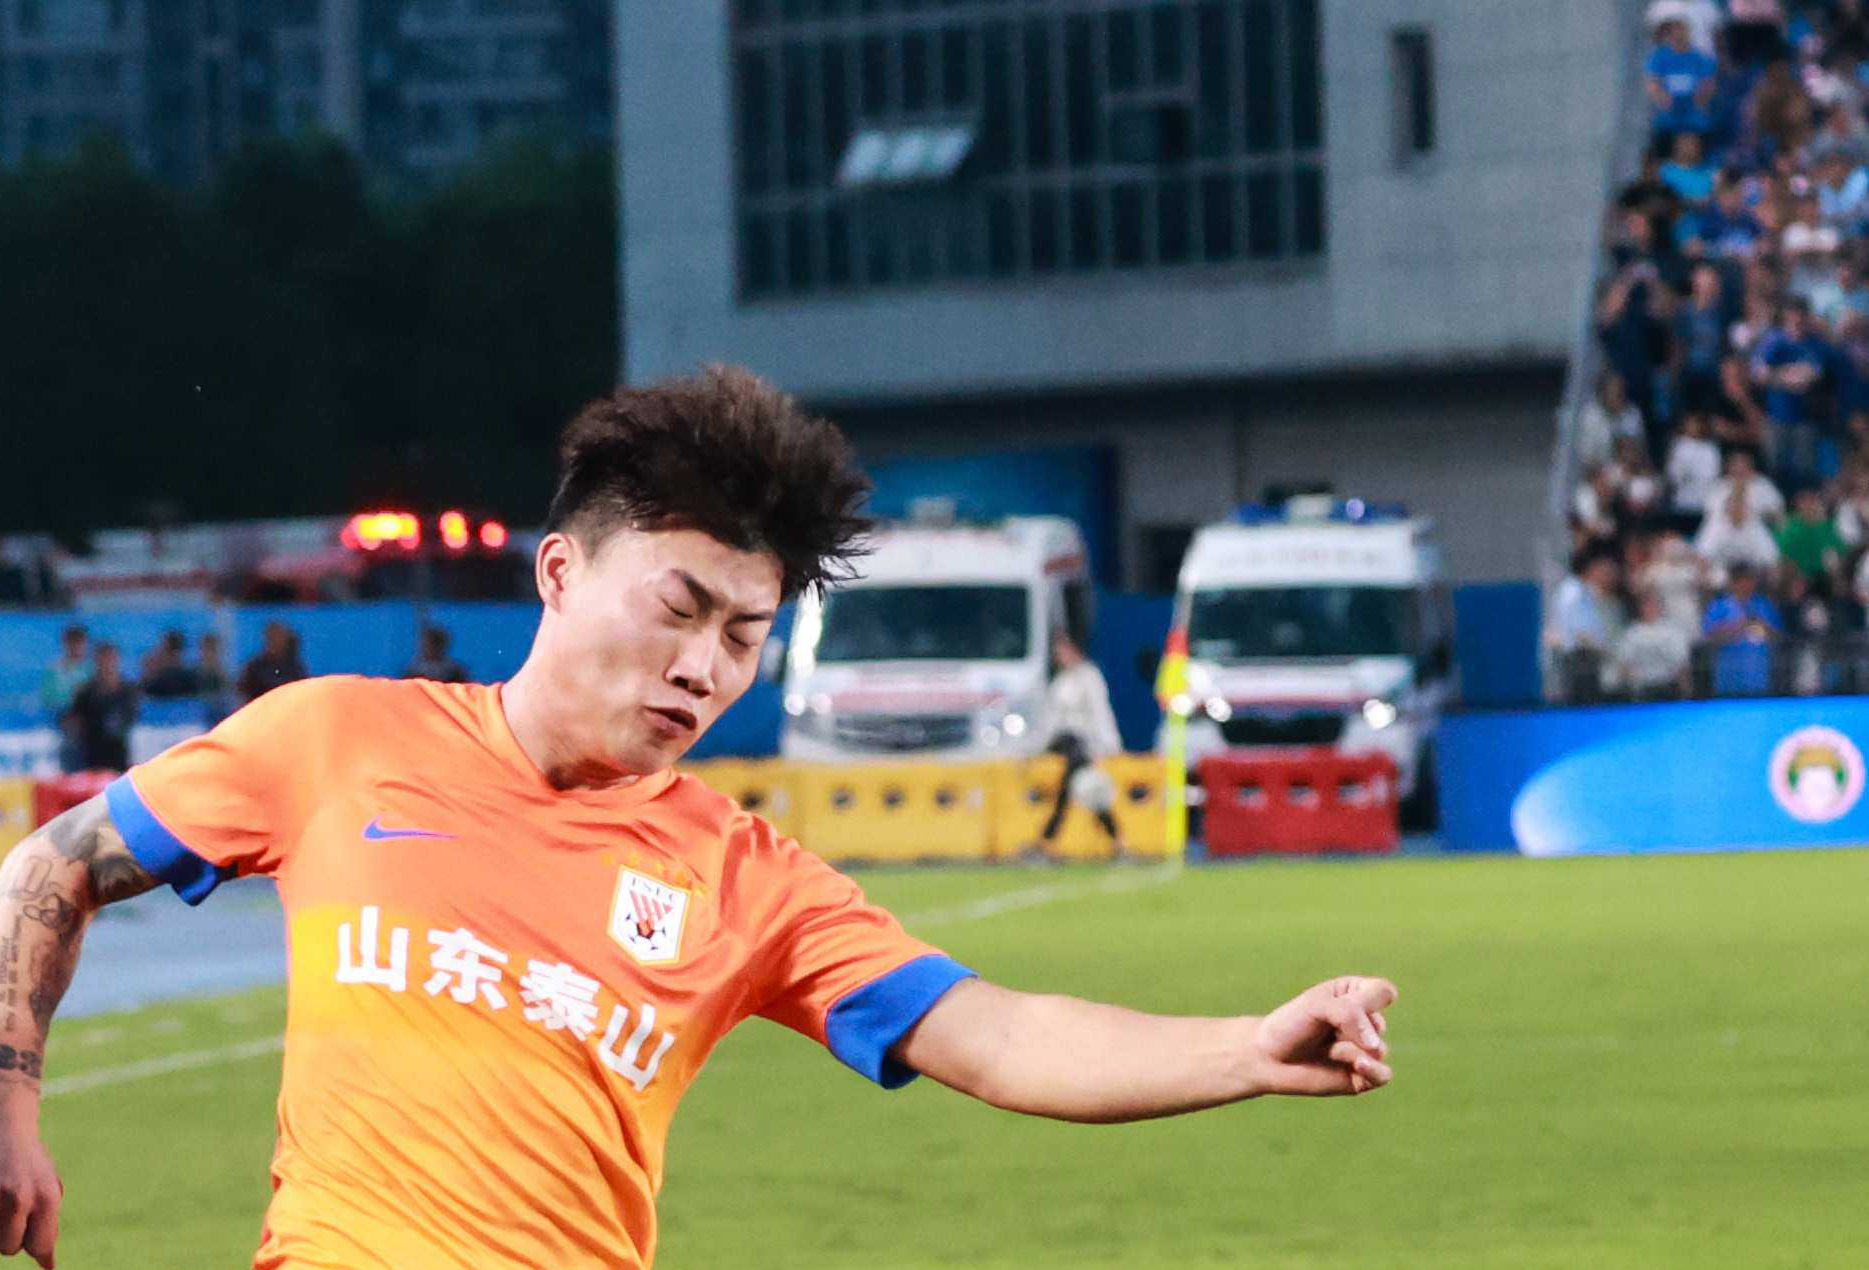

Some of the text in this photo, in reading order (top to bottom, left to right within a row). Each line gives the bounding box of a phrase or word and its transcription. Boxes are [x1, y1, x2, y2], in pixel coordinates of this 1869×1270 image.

[627, 874, 680, 905] TSFC
[335, 905, 676, 1092] 山东泰山
